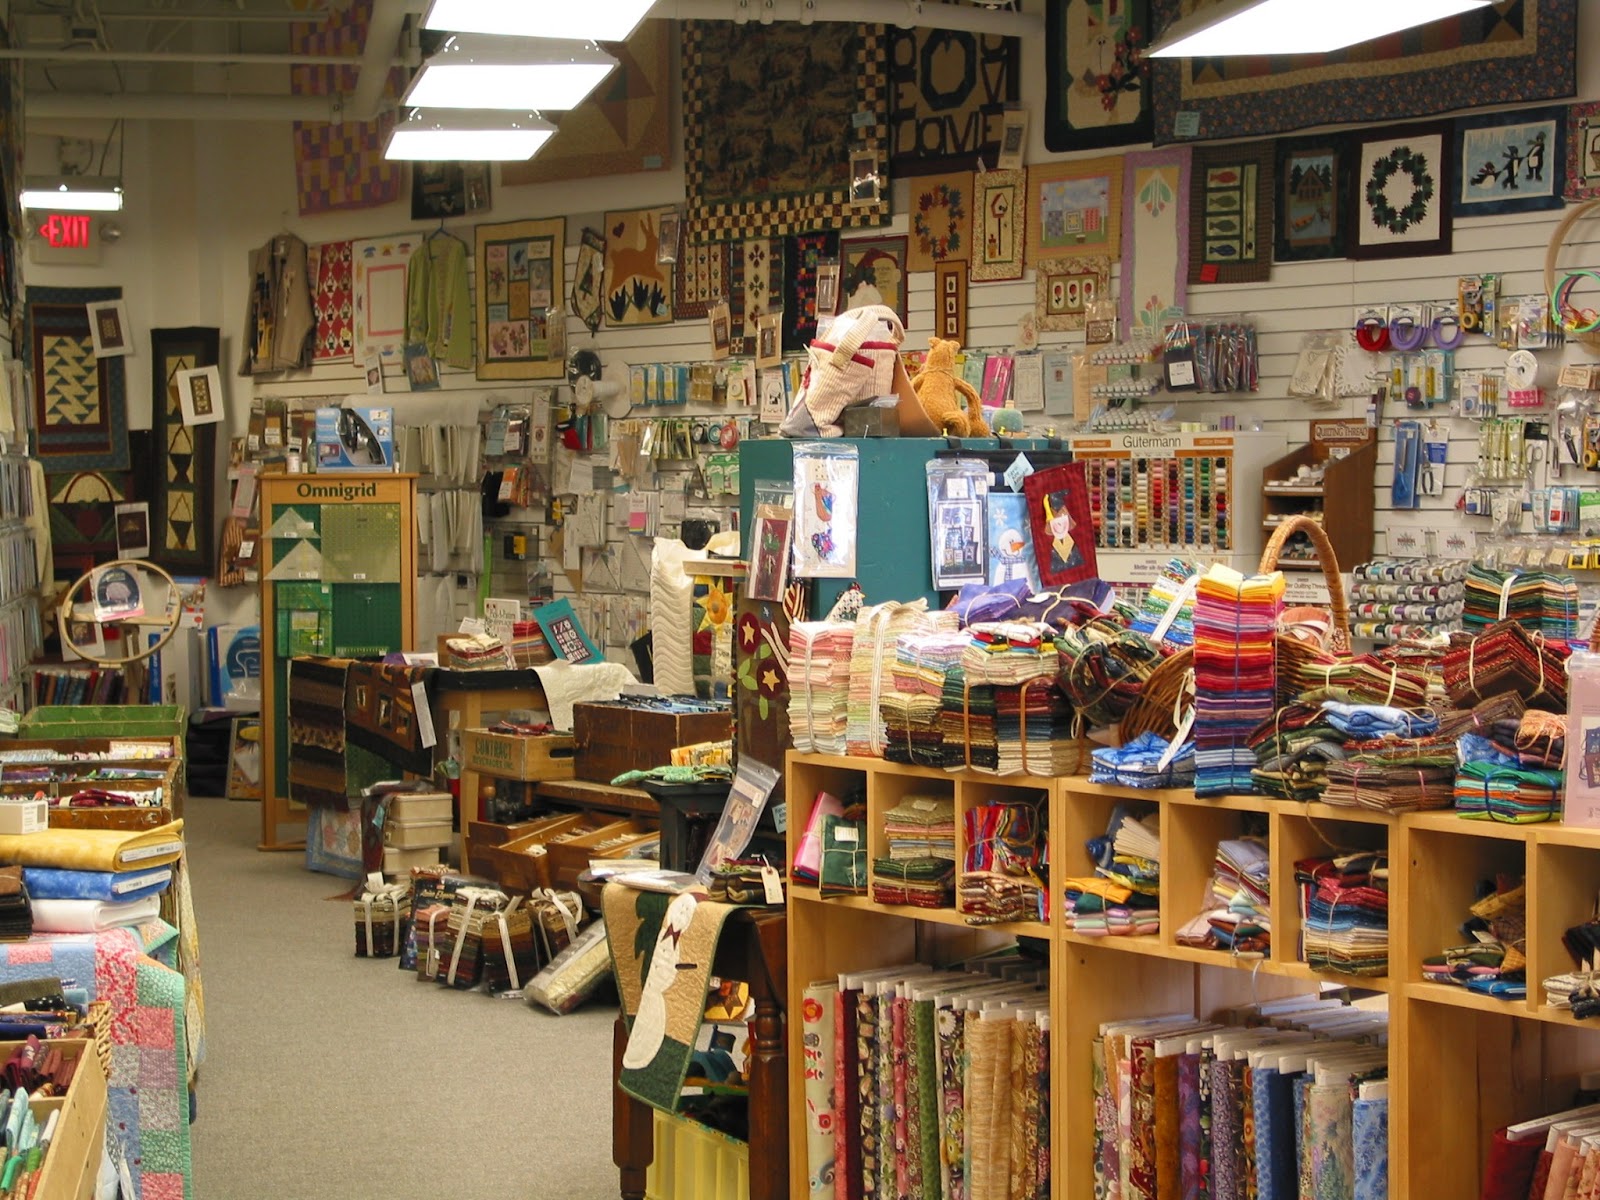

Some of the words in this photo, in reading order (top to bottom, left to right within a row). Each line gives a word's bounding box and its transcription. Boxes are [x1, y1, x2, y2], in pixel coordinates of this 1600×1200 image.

[48, 215, 91, 248] EXIT
[297, 483, 376, 501] Omnigrid
[475, 736, 513, 761] CONTRACT
